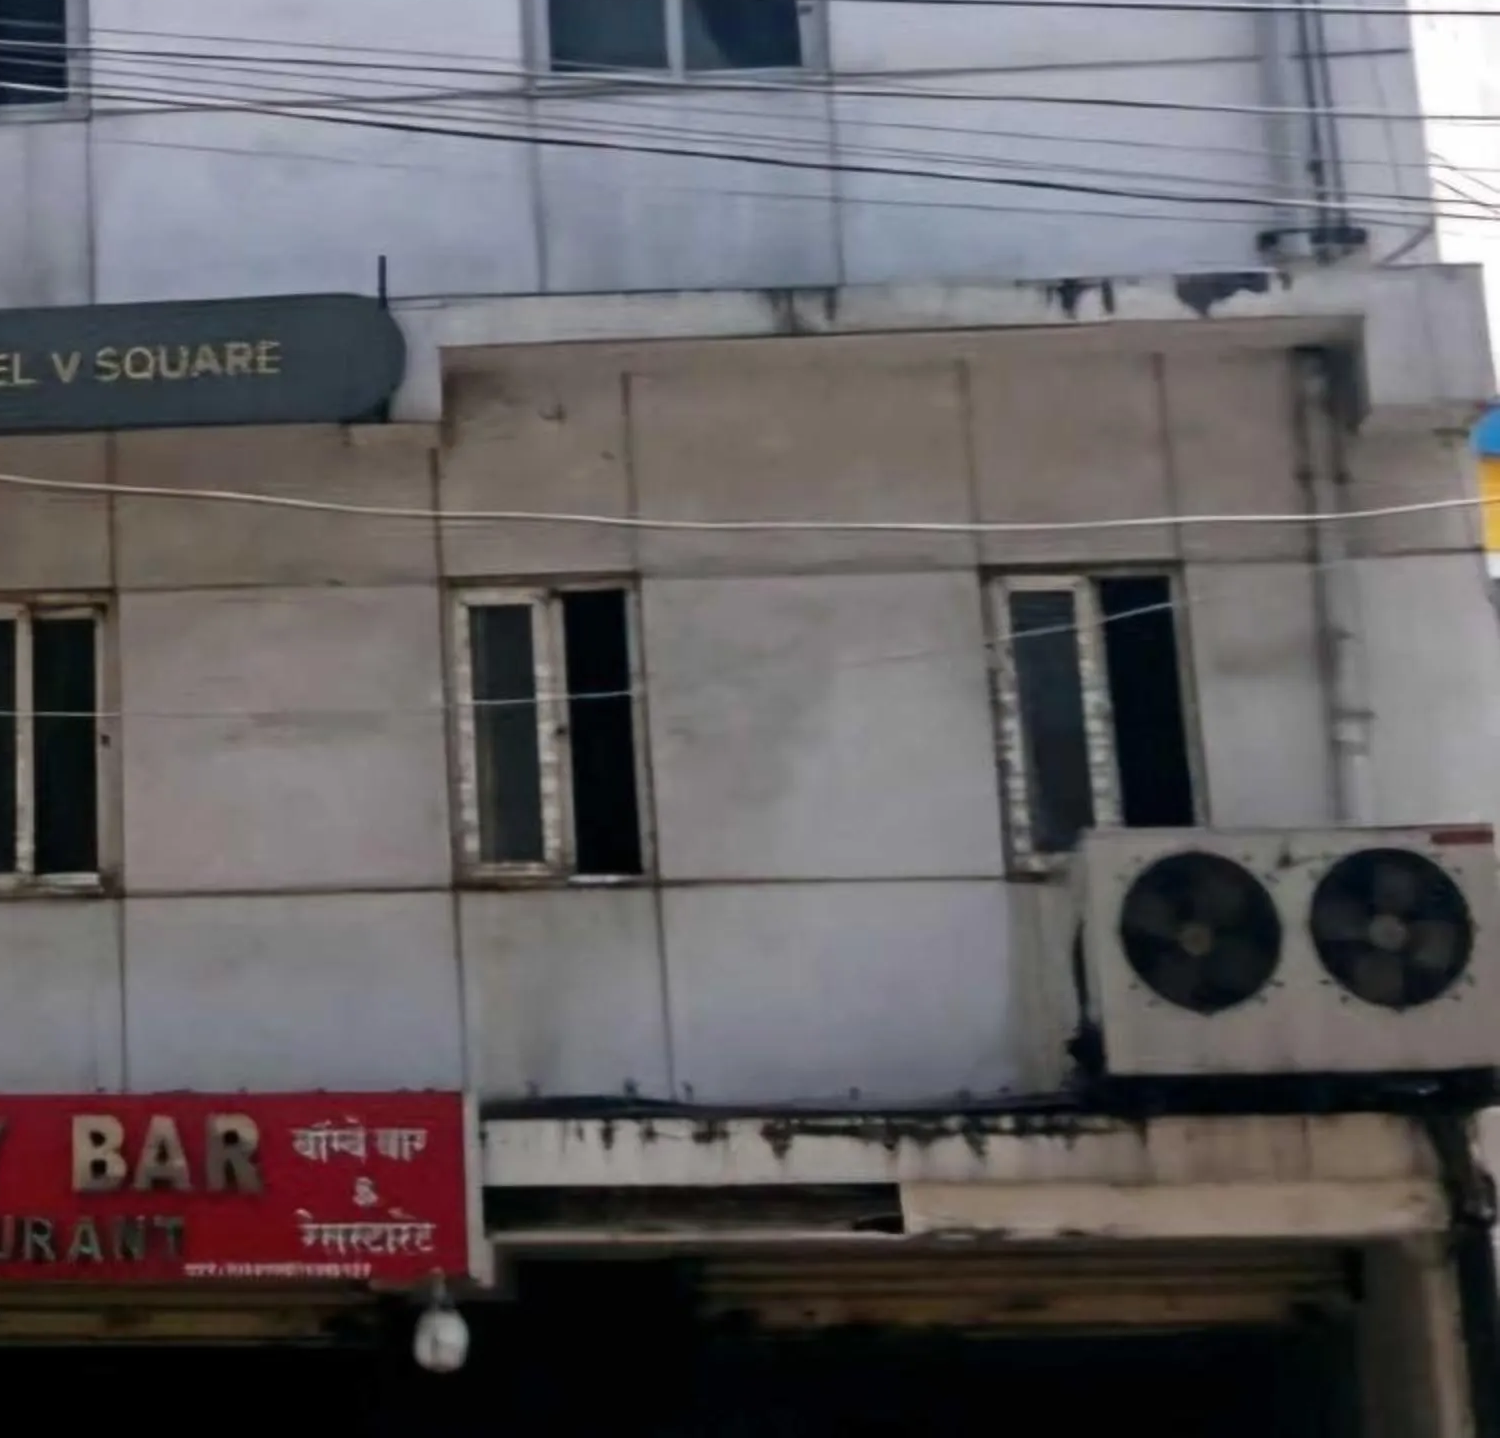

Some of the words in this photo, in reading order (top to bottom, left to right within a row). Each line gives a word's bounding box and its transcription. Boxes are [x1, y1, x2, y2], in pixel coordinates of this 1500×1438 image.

[55, 349, 83, 386] V
[93, 339, 283, 384] SQUARE
[72, 1113, 265, 1195] BAR
